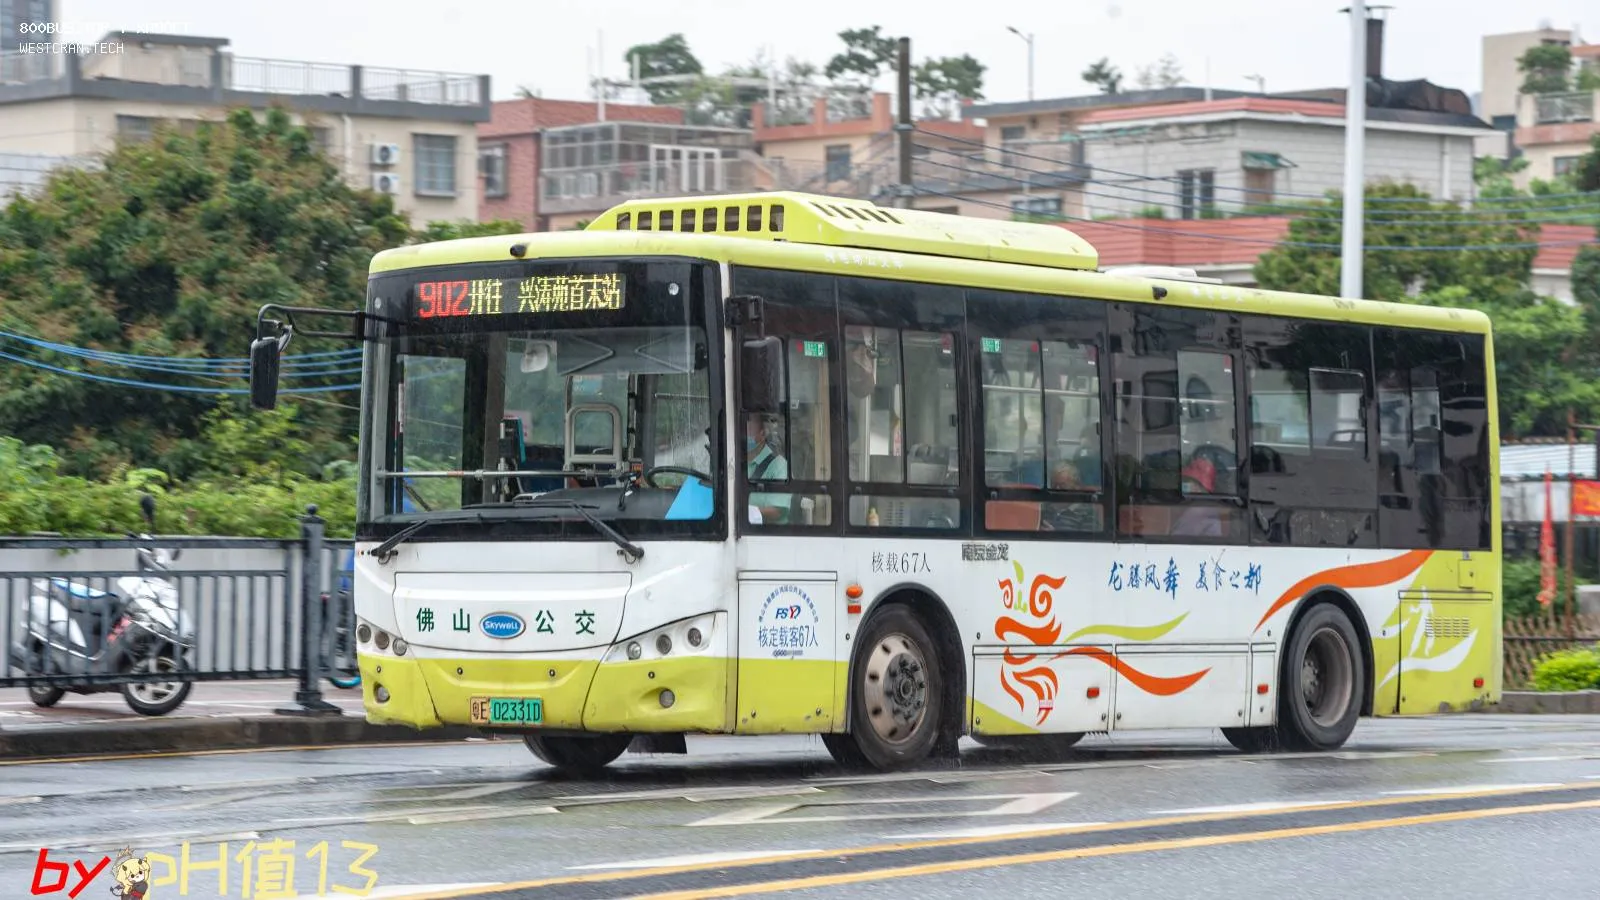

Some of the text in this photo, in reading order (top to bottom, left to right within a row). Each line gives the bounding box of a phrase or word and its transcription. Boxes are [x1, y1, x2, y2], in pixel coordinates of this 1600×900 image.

[419, 281, 468, 318] 902
[468, 278, 502, 314] 开往
[872, 551, 931, 574] 核载67人
[758, 625, 819, 648] 核定载客67人
